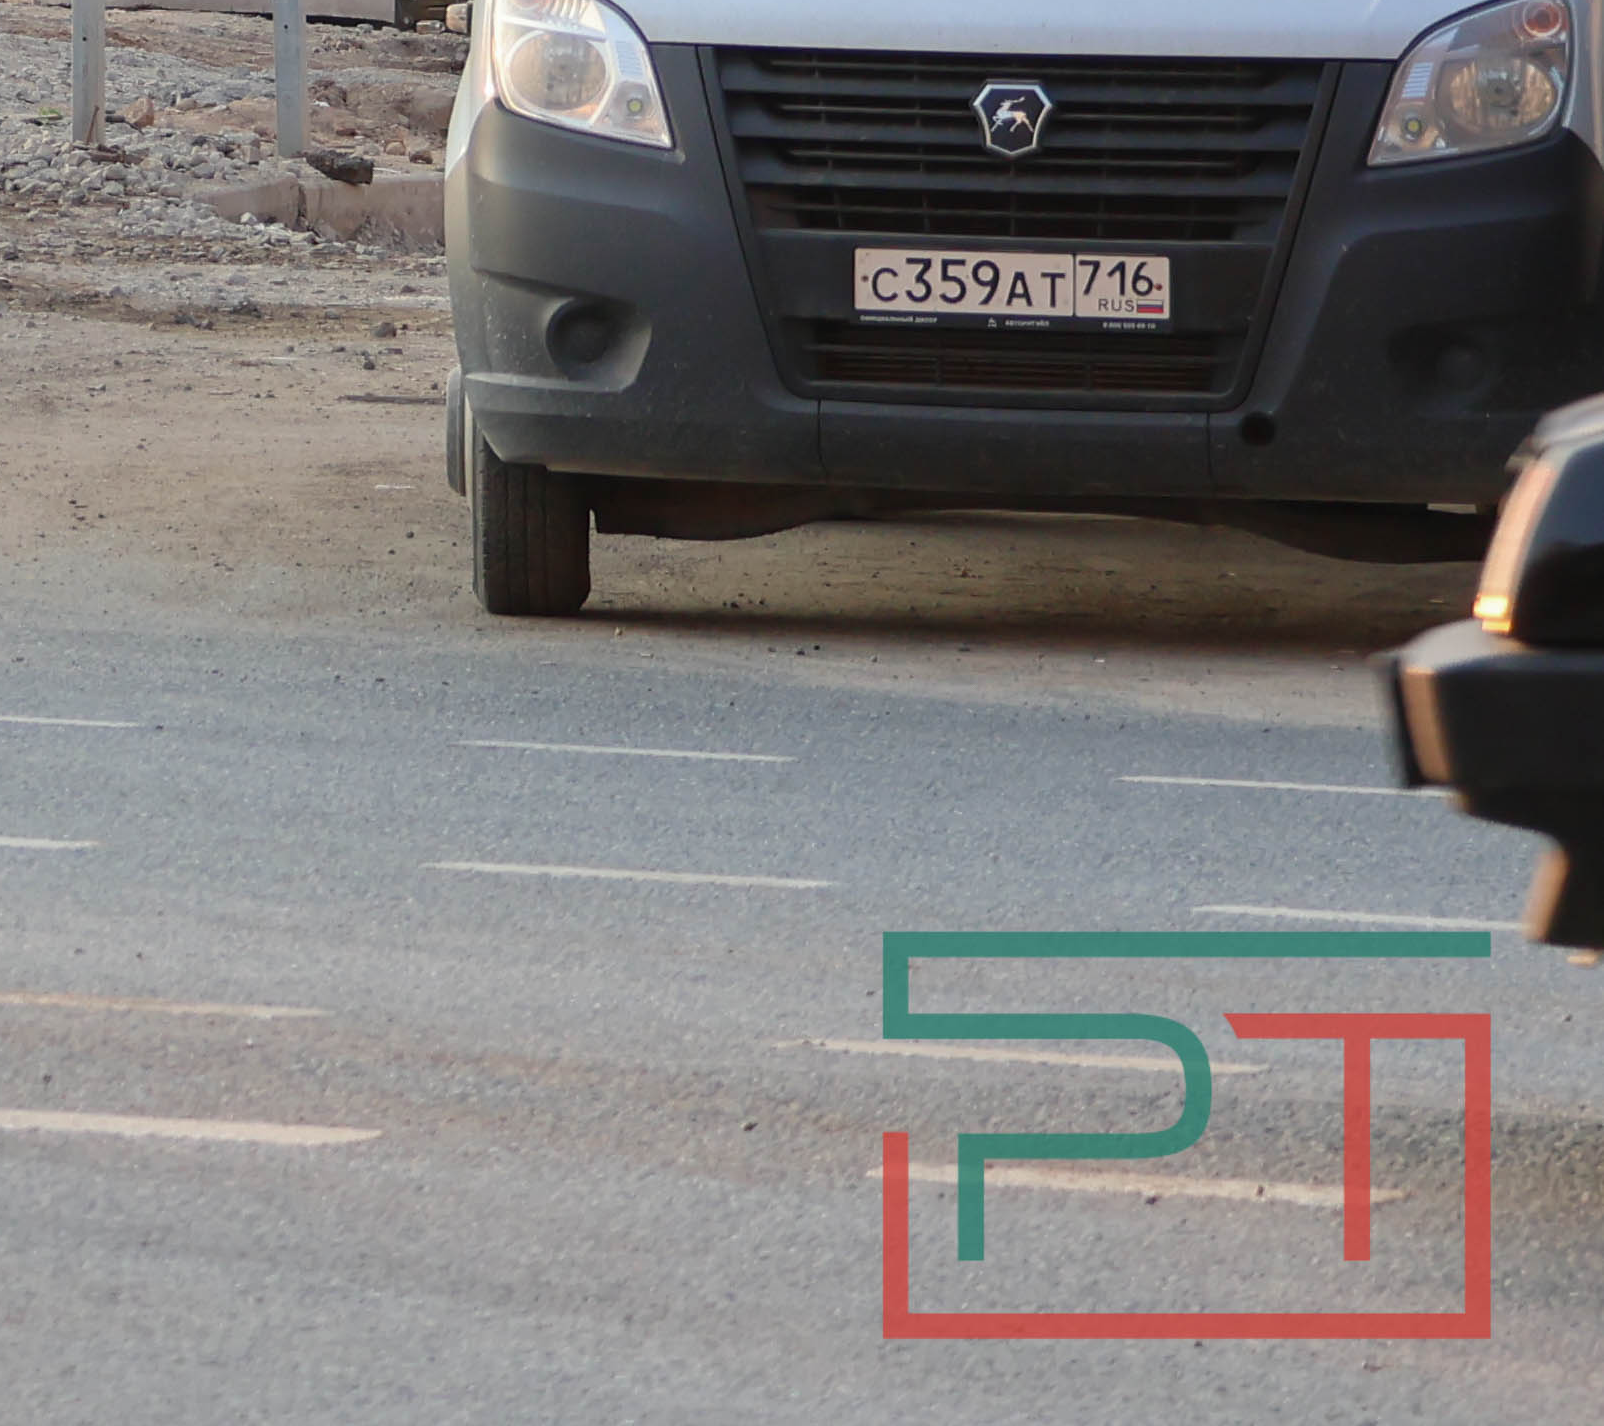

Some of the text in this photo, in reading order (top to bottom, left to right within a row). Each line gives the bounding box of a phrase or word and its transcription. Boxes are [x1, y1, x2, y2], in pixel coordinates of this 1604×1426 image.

[871, 257, 1154, 308] С359АТ 716
[1097, 299, 1135, 312] RUS
